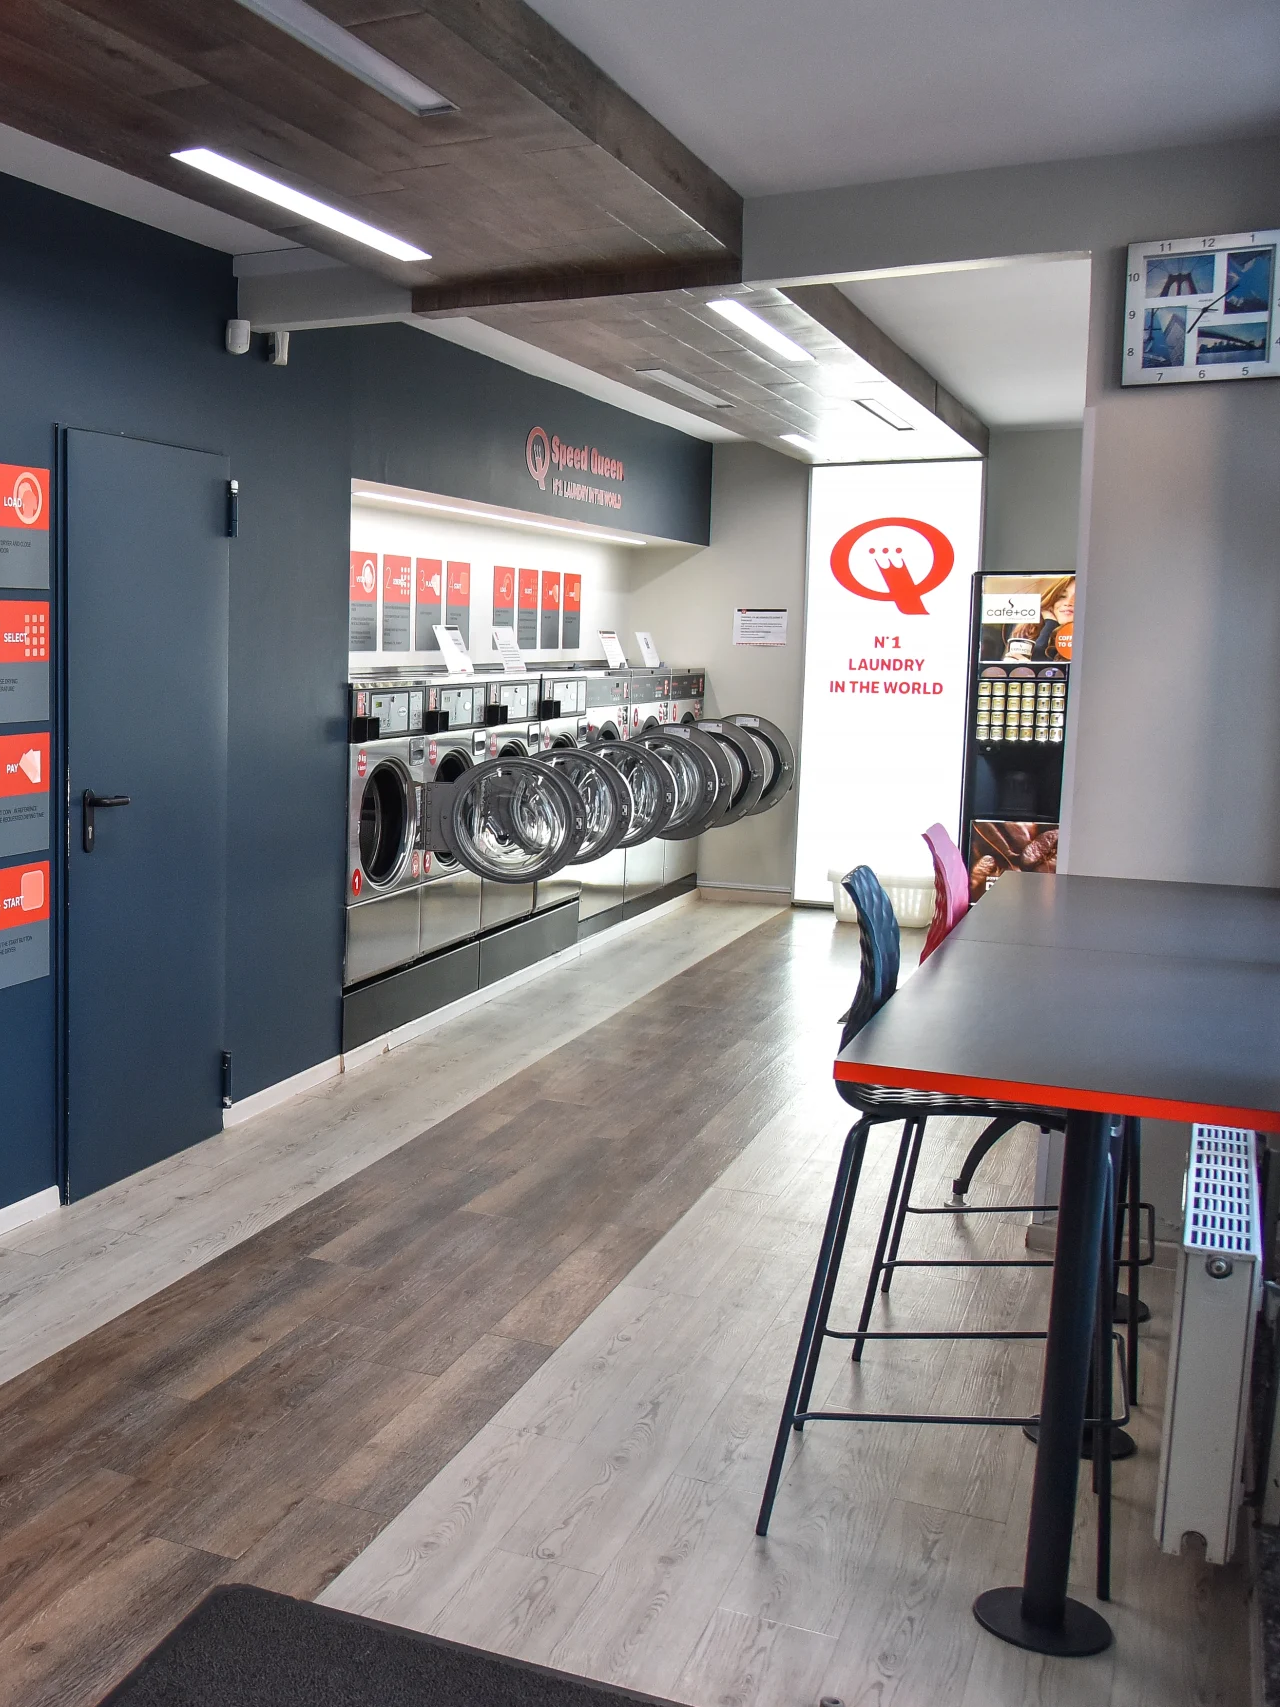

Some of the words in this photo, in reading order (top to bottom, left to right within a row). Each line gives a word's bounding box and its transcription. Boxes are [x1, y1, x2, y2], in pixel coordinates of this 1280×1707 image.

[1160, 243, 1172, 252] 11
[1202, 238, 1215, 247] 12
[1251, 234, 1255, 243] 1
[1128, 273, 1140, 282] 10
[1128, 310, 1136, 319] 9
[1127, 348, 1134, 356] 8
[1157, 372, 1164, 381] 7
[1198, 370, 1205, 378] 6
[1242, 367, 1249, 375] 5
[551, 435, 589, 471] Speed
[591, 447, 624, 481] Queen
[3, 496, 22, 508] LOAD
[564, 480, 588, 503] LAUNDRY
[604, 491, 622, 510] WORLD
[4, 632, 28, 643] SELECT
[848, 658, 925, 672] LAUNDRY
[829, 680, 846, 694] IN
[849, 680, 881, 694] THE
[883, 681, 943, 695] WORLD
[6, 763, 19, 774] PAY
[426, 854, 430, 867] 2
[354, 876, 358, 890] 1
[3, 896, 24, 910] START
